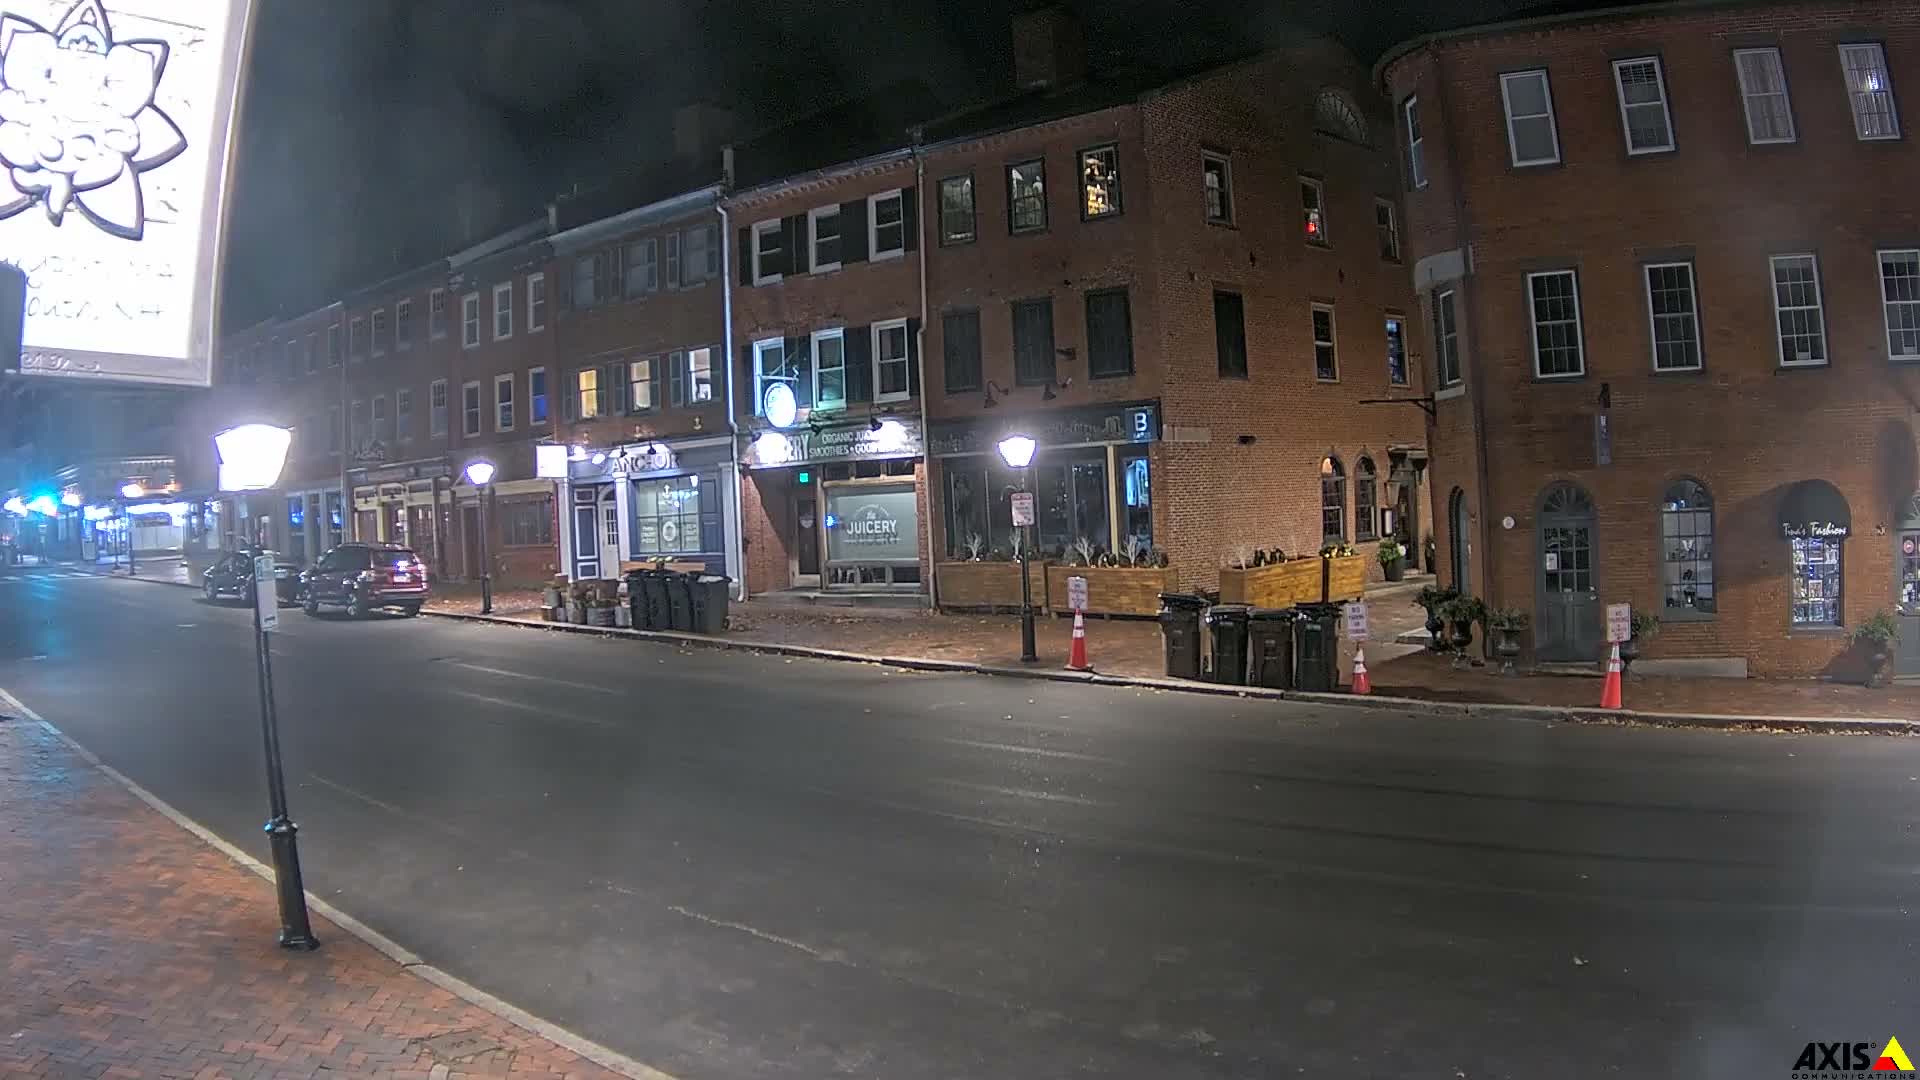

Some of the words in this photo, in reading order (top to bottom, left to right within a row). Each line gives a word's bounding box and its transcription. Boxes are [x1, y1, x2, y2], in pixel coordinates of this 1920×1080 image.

[1134, 412, 1147, 431] B
[821, 431, 853, 444] ORGANIC
[809, 444, 849, 457] SMOOTHIES
[846, 519, 897, 535] JUICERY
